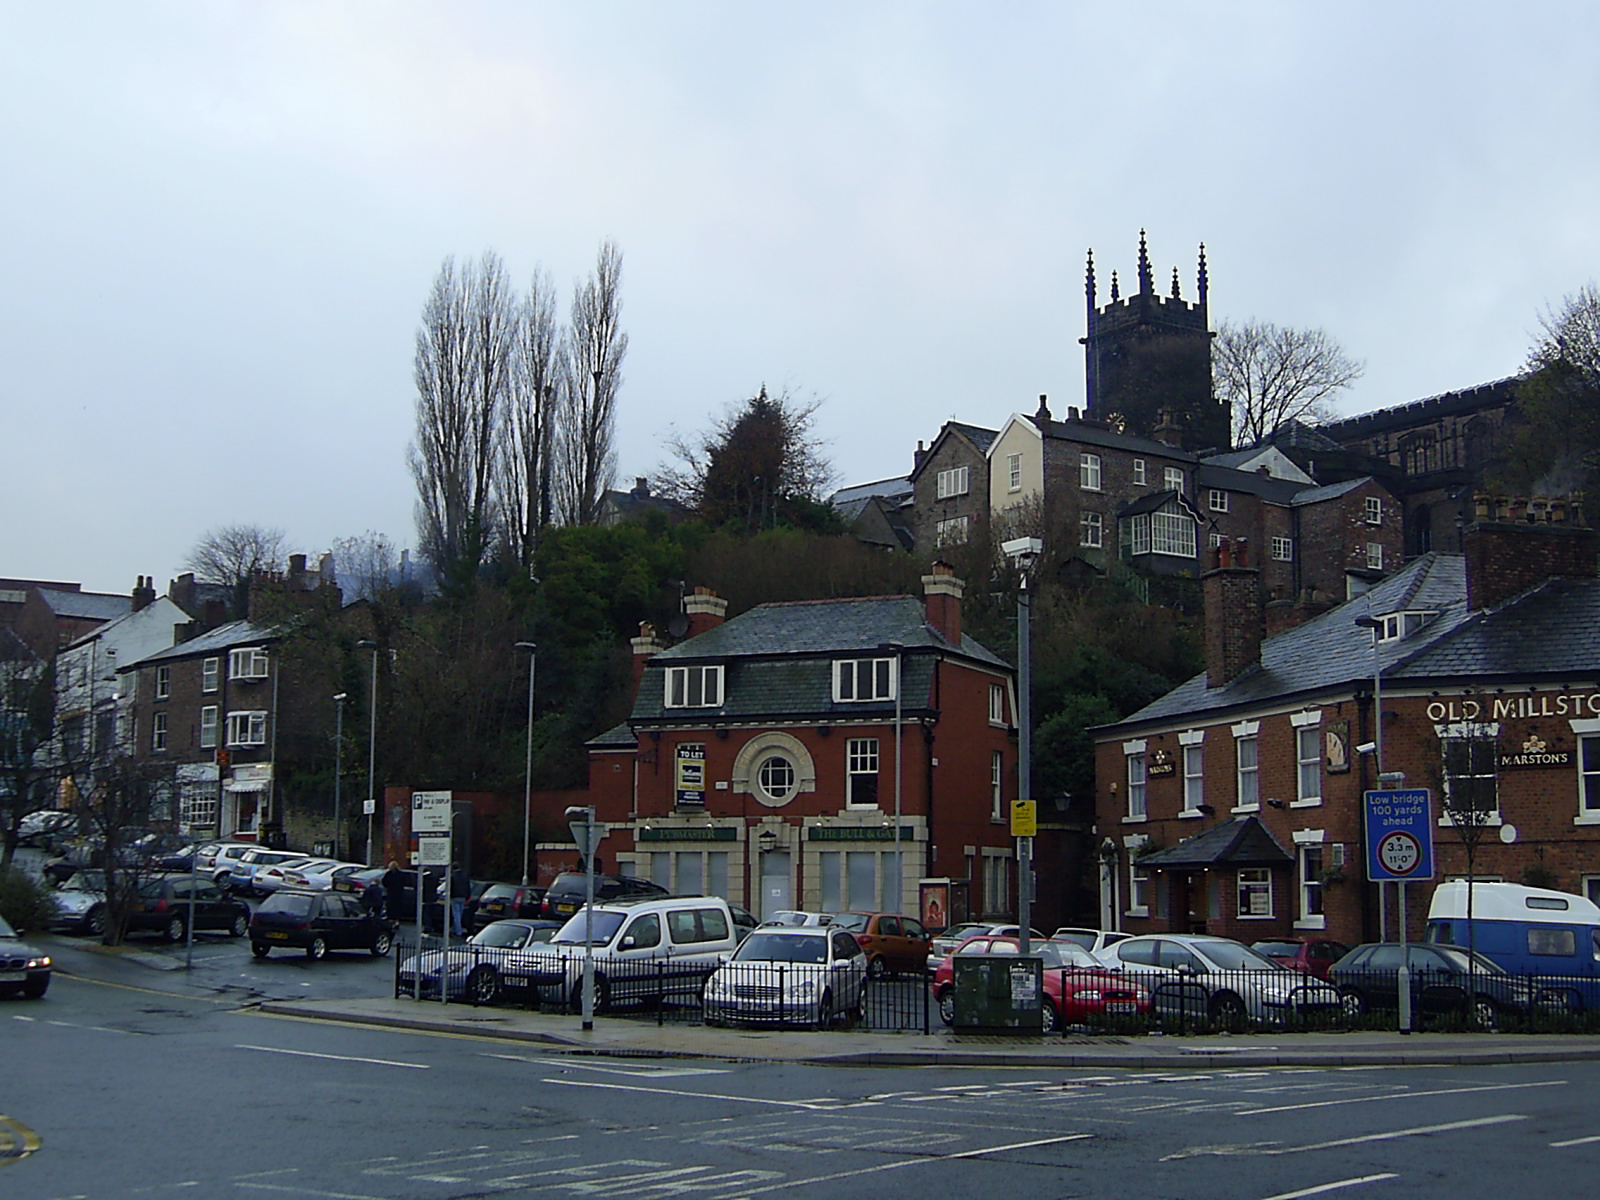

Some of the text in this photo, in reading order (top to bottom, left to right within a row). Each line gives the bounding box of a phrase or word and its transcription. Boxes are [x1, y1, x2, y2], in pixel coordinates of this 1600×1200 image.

[1427, 693, 1600, 721] OLD MILLSTO
[691, 751, 704, 759] LET
[1501, 753, 1568, 766] MARSTON'S
[1369, 794, 1425, 805] Low bridge
[1372, 805, 1423, 816] 100 yards
[1382, 816, 1414, 826] ahead
[819, 829, 837, 839] THE
[840, 828, 865, 839] BULL
[1387, 843, 1403, 852] 3.3
